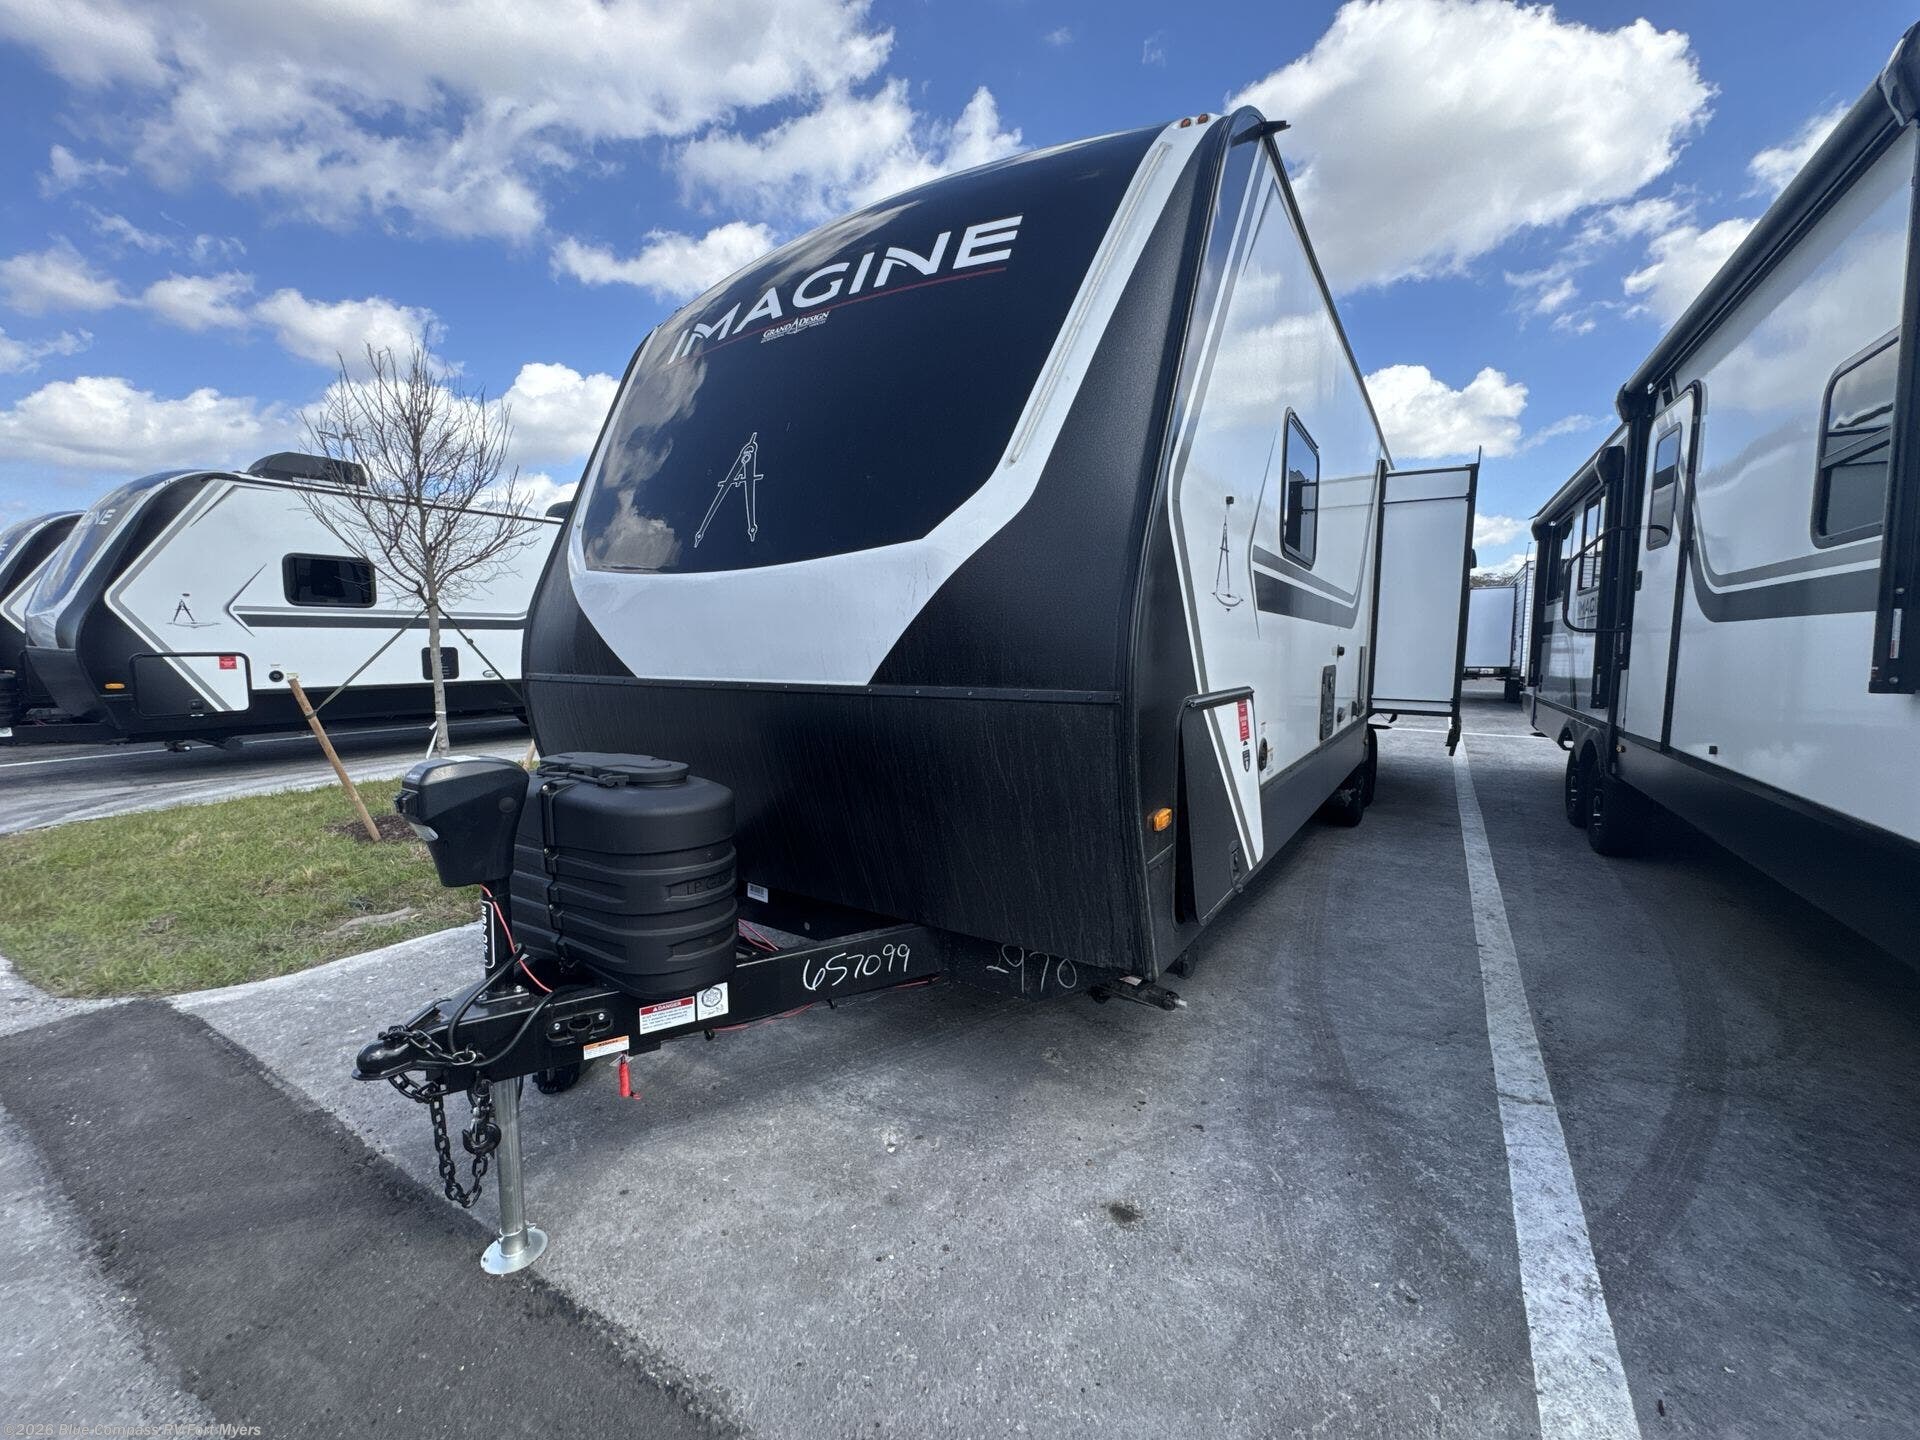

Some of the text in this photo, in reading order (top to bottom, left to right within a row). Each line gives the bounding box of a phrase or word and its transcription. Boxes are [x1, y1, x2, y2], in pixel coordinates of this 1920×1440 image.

[667, 215, 1023, 365] IMAGINE
[802, 943, 911, 991] 657099
[657, 1001, 682, 1011] DANGER
